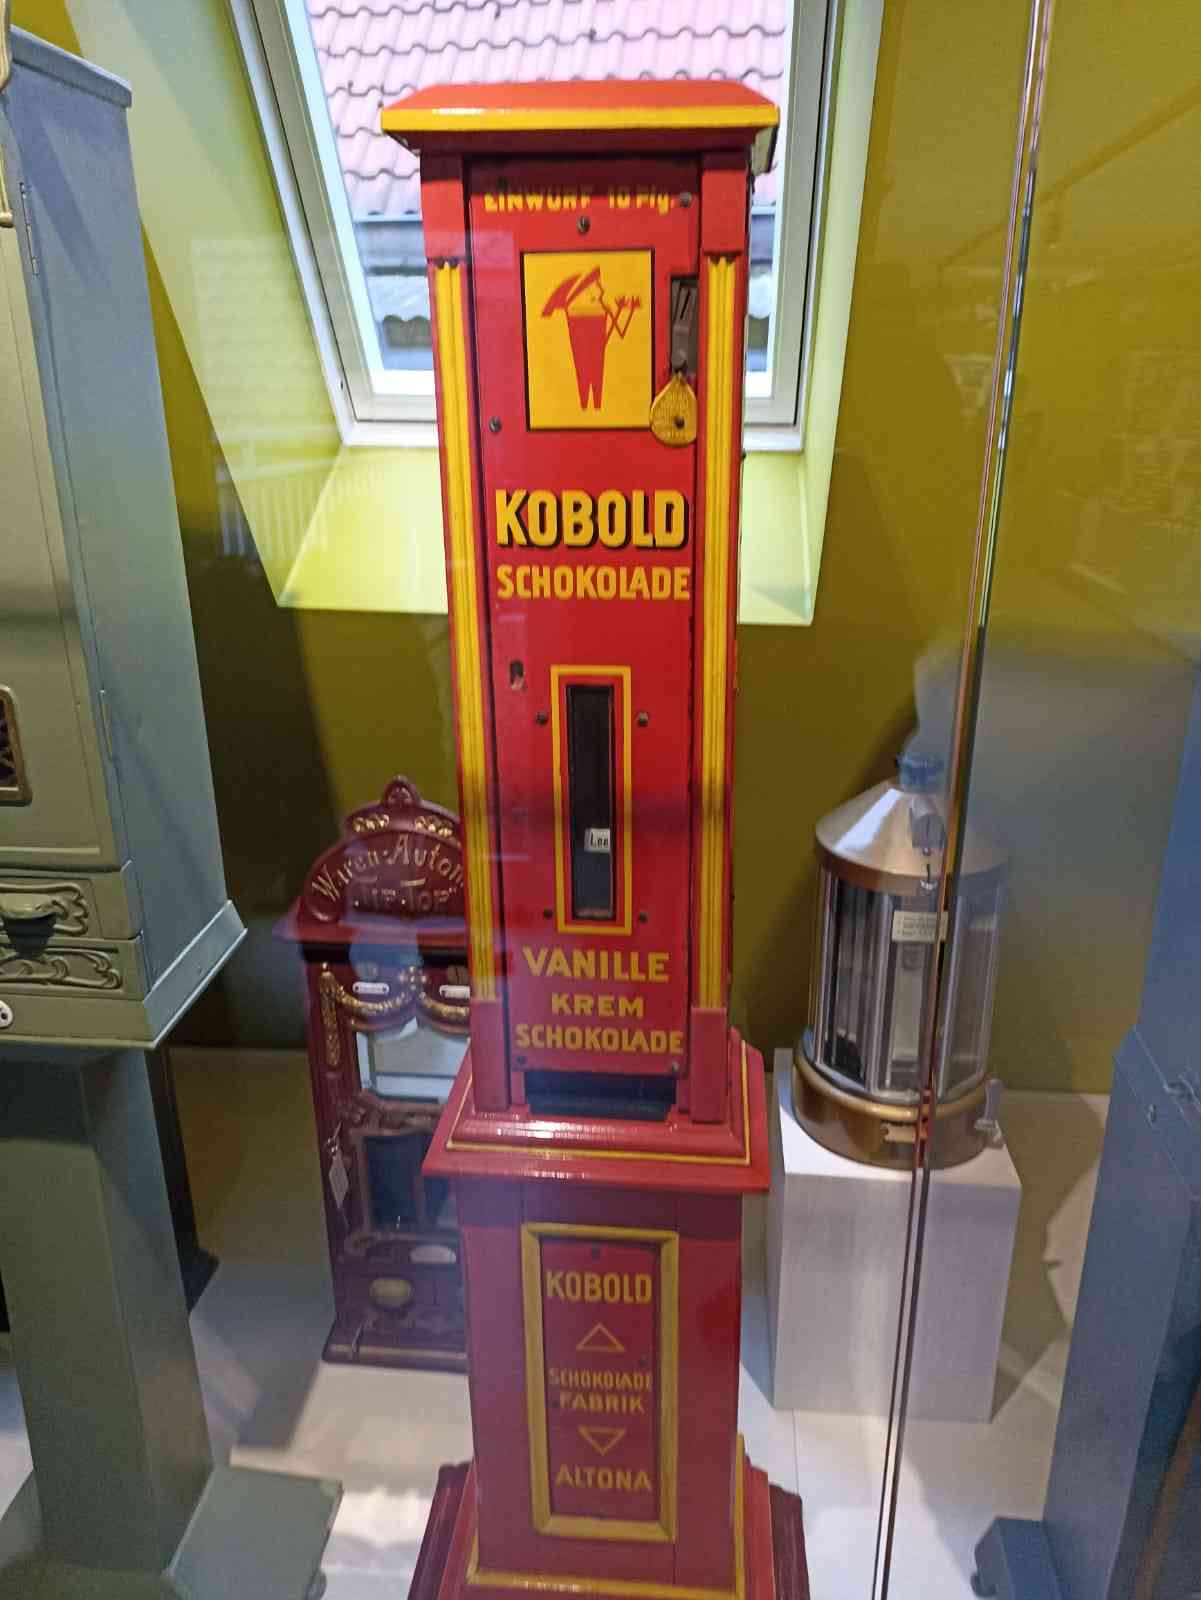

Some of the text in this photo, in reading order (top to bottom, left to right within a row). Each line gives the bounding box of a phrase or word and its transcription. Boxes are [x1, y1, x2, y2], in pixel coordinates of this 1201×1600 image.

[484, 187, 591, 212] EINWURF
[495, 488, 688, 548] KOBOLD
[496, 564, 691, 601] SCHOKOLADE
[522, 944, 670, 983] VANILLE
[551, 992, 644, 1020] KREM
[515, 1022, 685, 1056] SCHOKOLADE
[545, 1269, 653, 1305] KOBOLD
[559, 1391, 646, 1415] FABRIK
[555, 1463, 653, 1493] ALTONA
